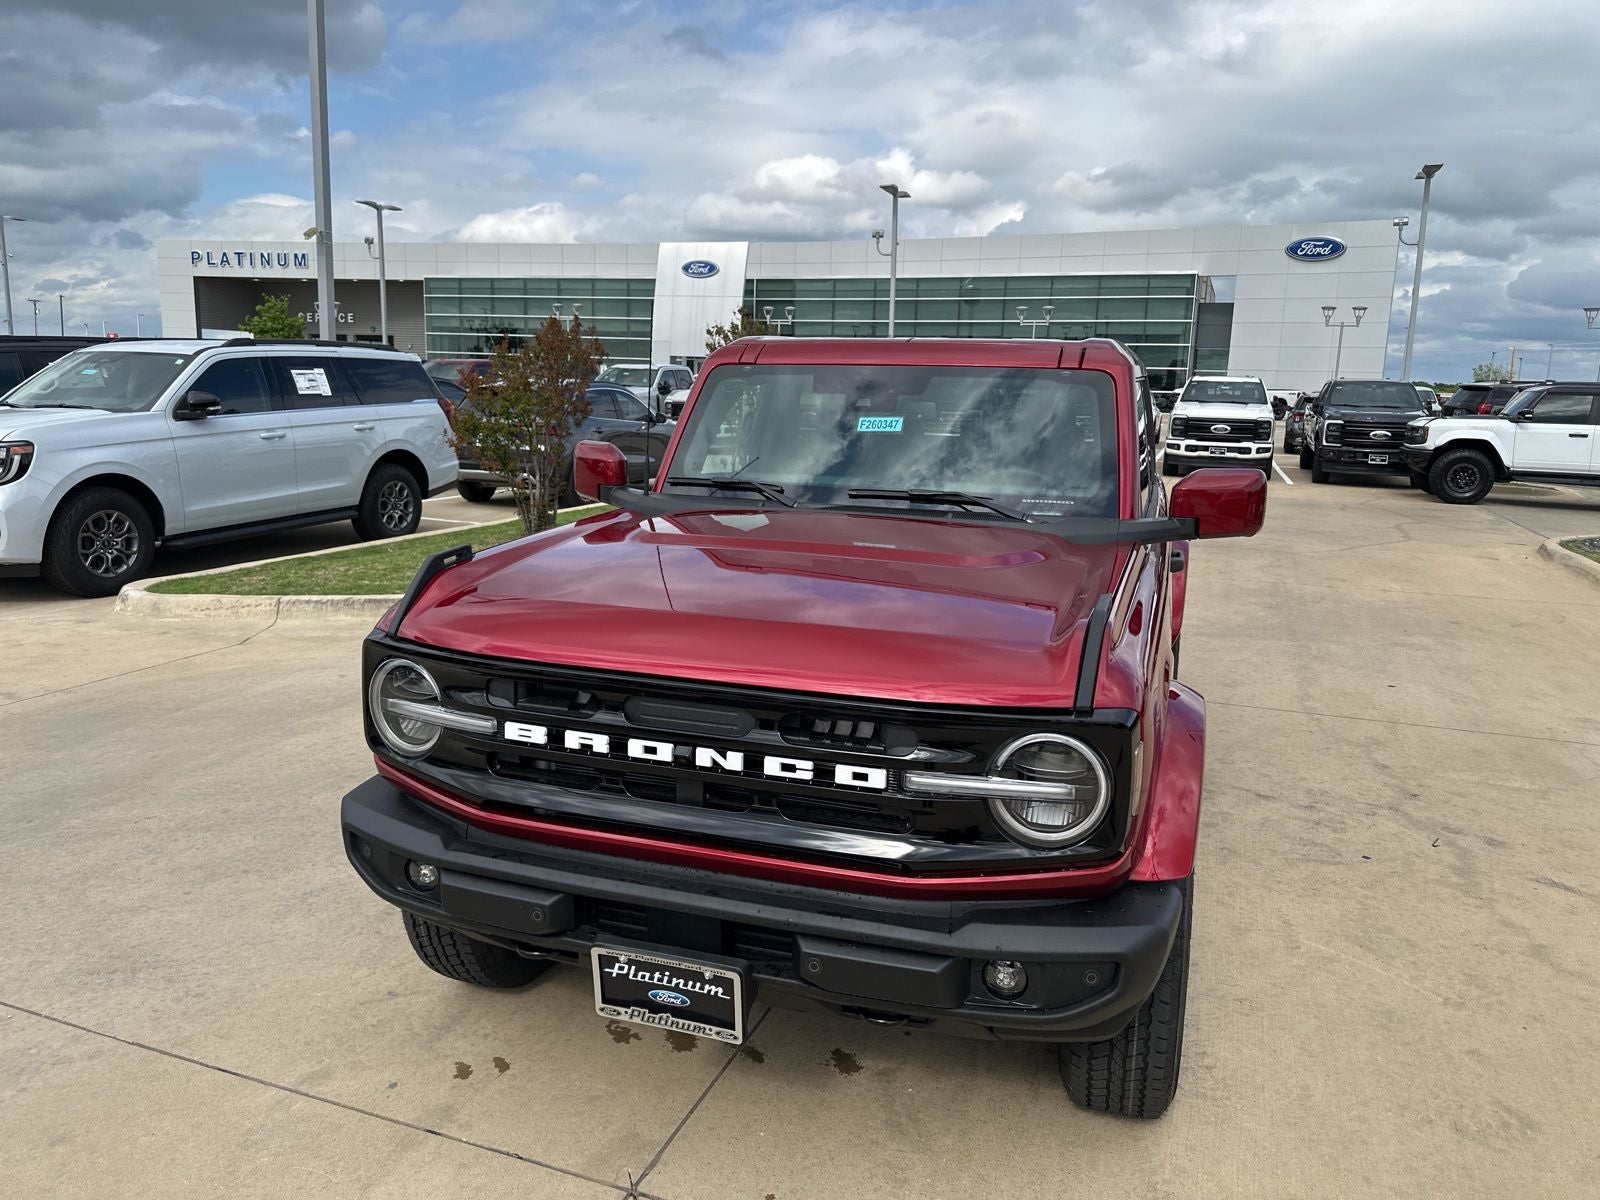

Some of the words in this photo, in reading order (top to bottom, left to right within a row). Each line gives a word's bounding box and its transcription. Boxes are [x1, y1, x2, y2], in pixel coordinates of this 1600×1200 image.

[1297, 241, 1333, 255] Ford
[190, 250, 308, 268] PLATINUM
[859, 419, 899, 430] F260347
[503, 720, 888, 789] BRONCO
[603, 962, 731, 999] Platinum
[656, 992, 682, 1005] Ford
[629, 1008, 713, 1036] Platinum
